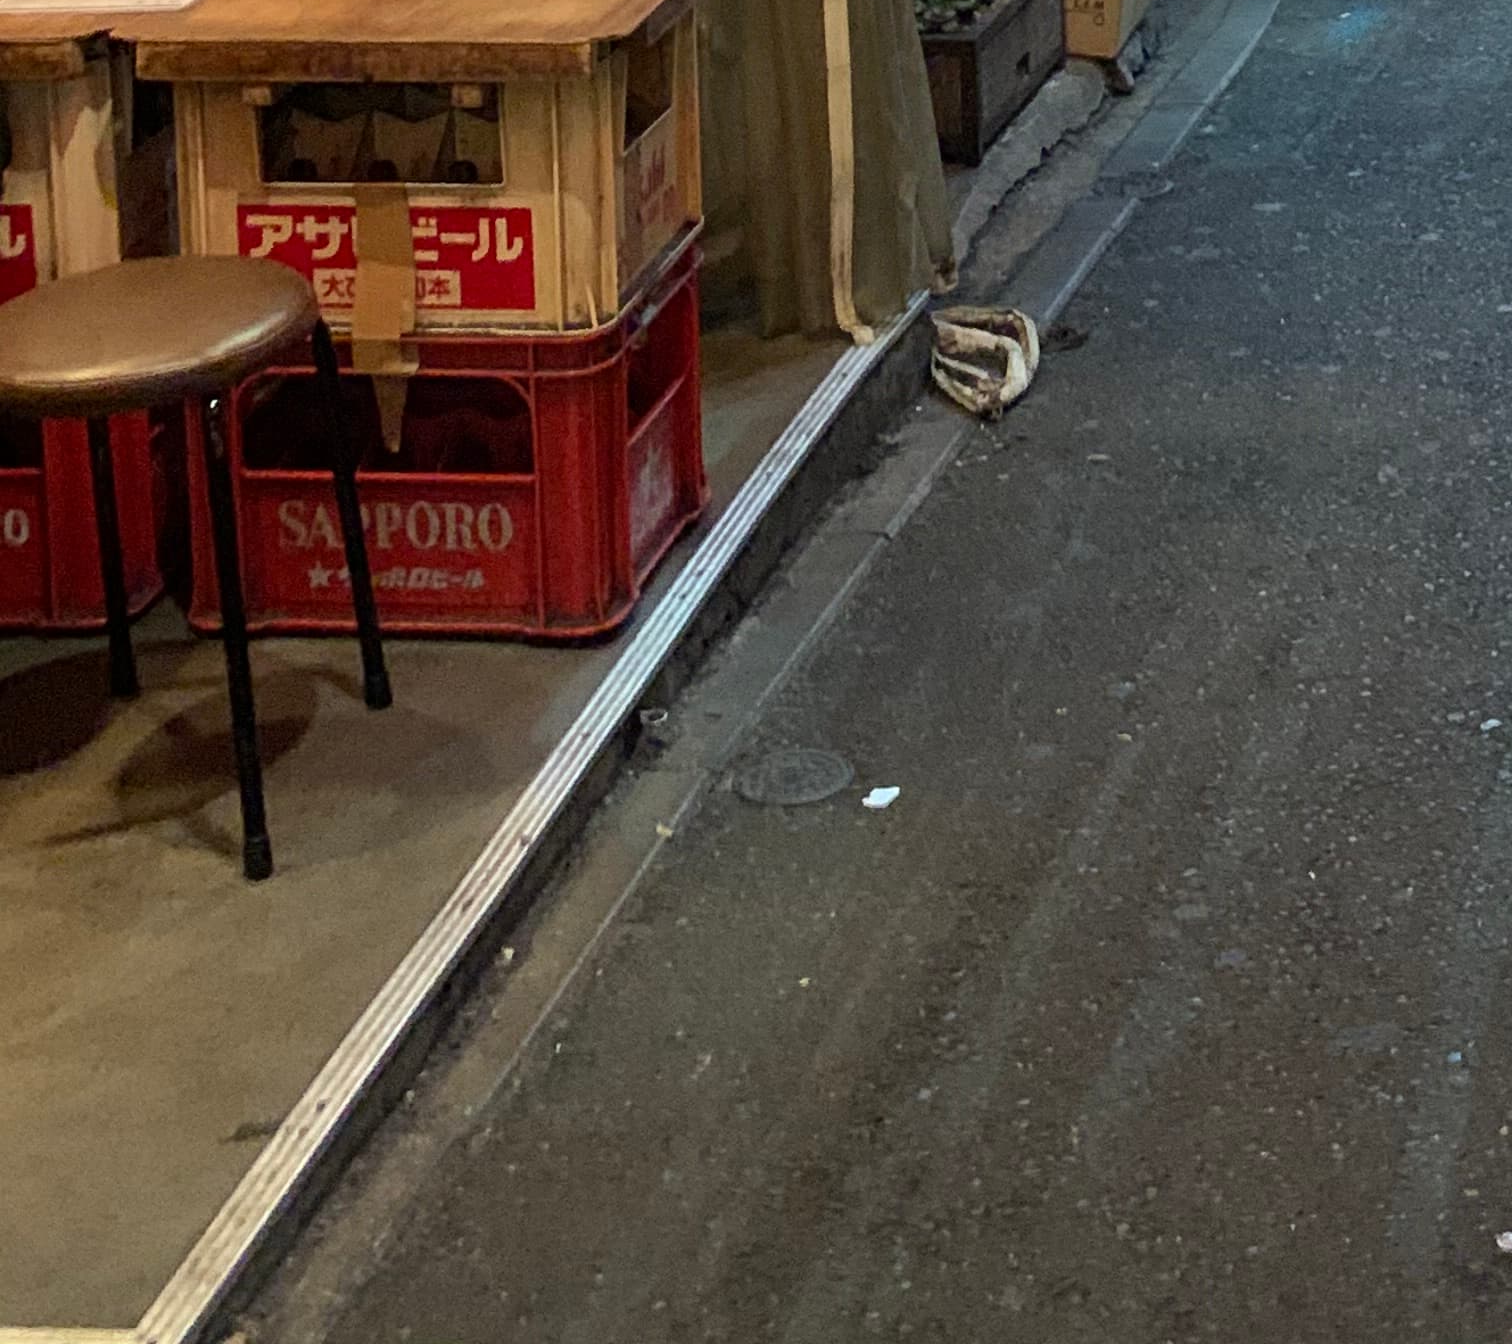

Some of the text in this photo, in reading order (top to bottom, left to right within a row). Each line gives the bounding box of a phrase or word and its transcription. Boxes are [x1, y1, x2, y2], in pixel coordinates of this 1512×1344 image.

[245, 214, 525, 263] アサビール
